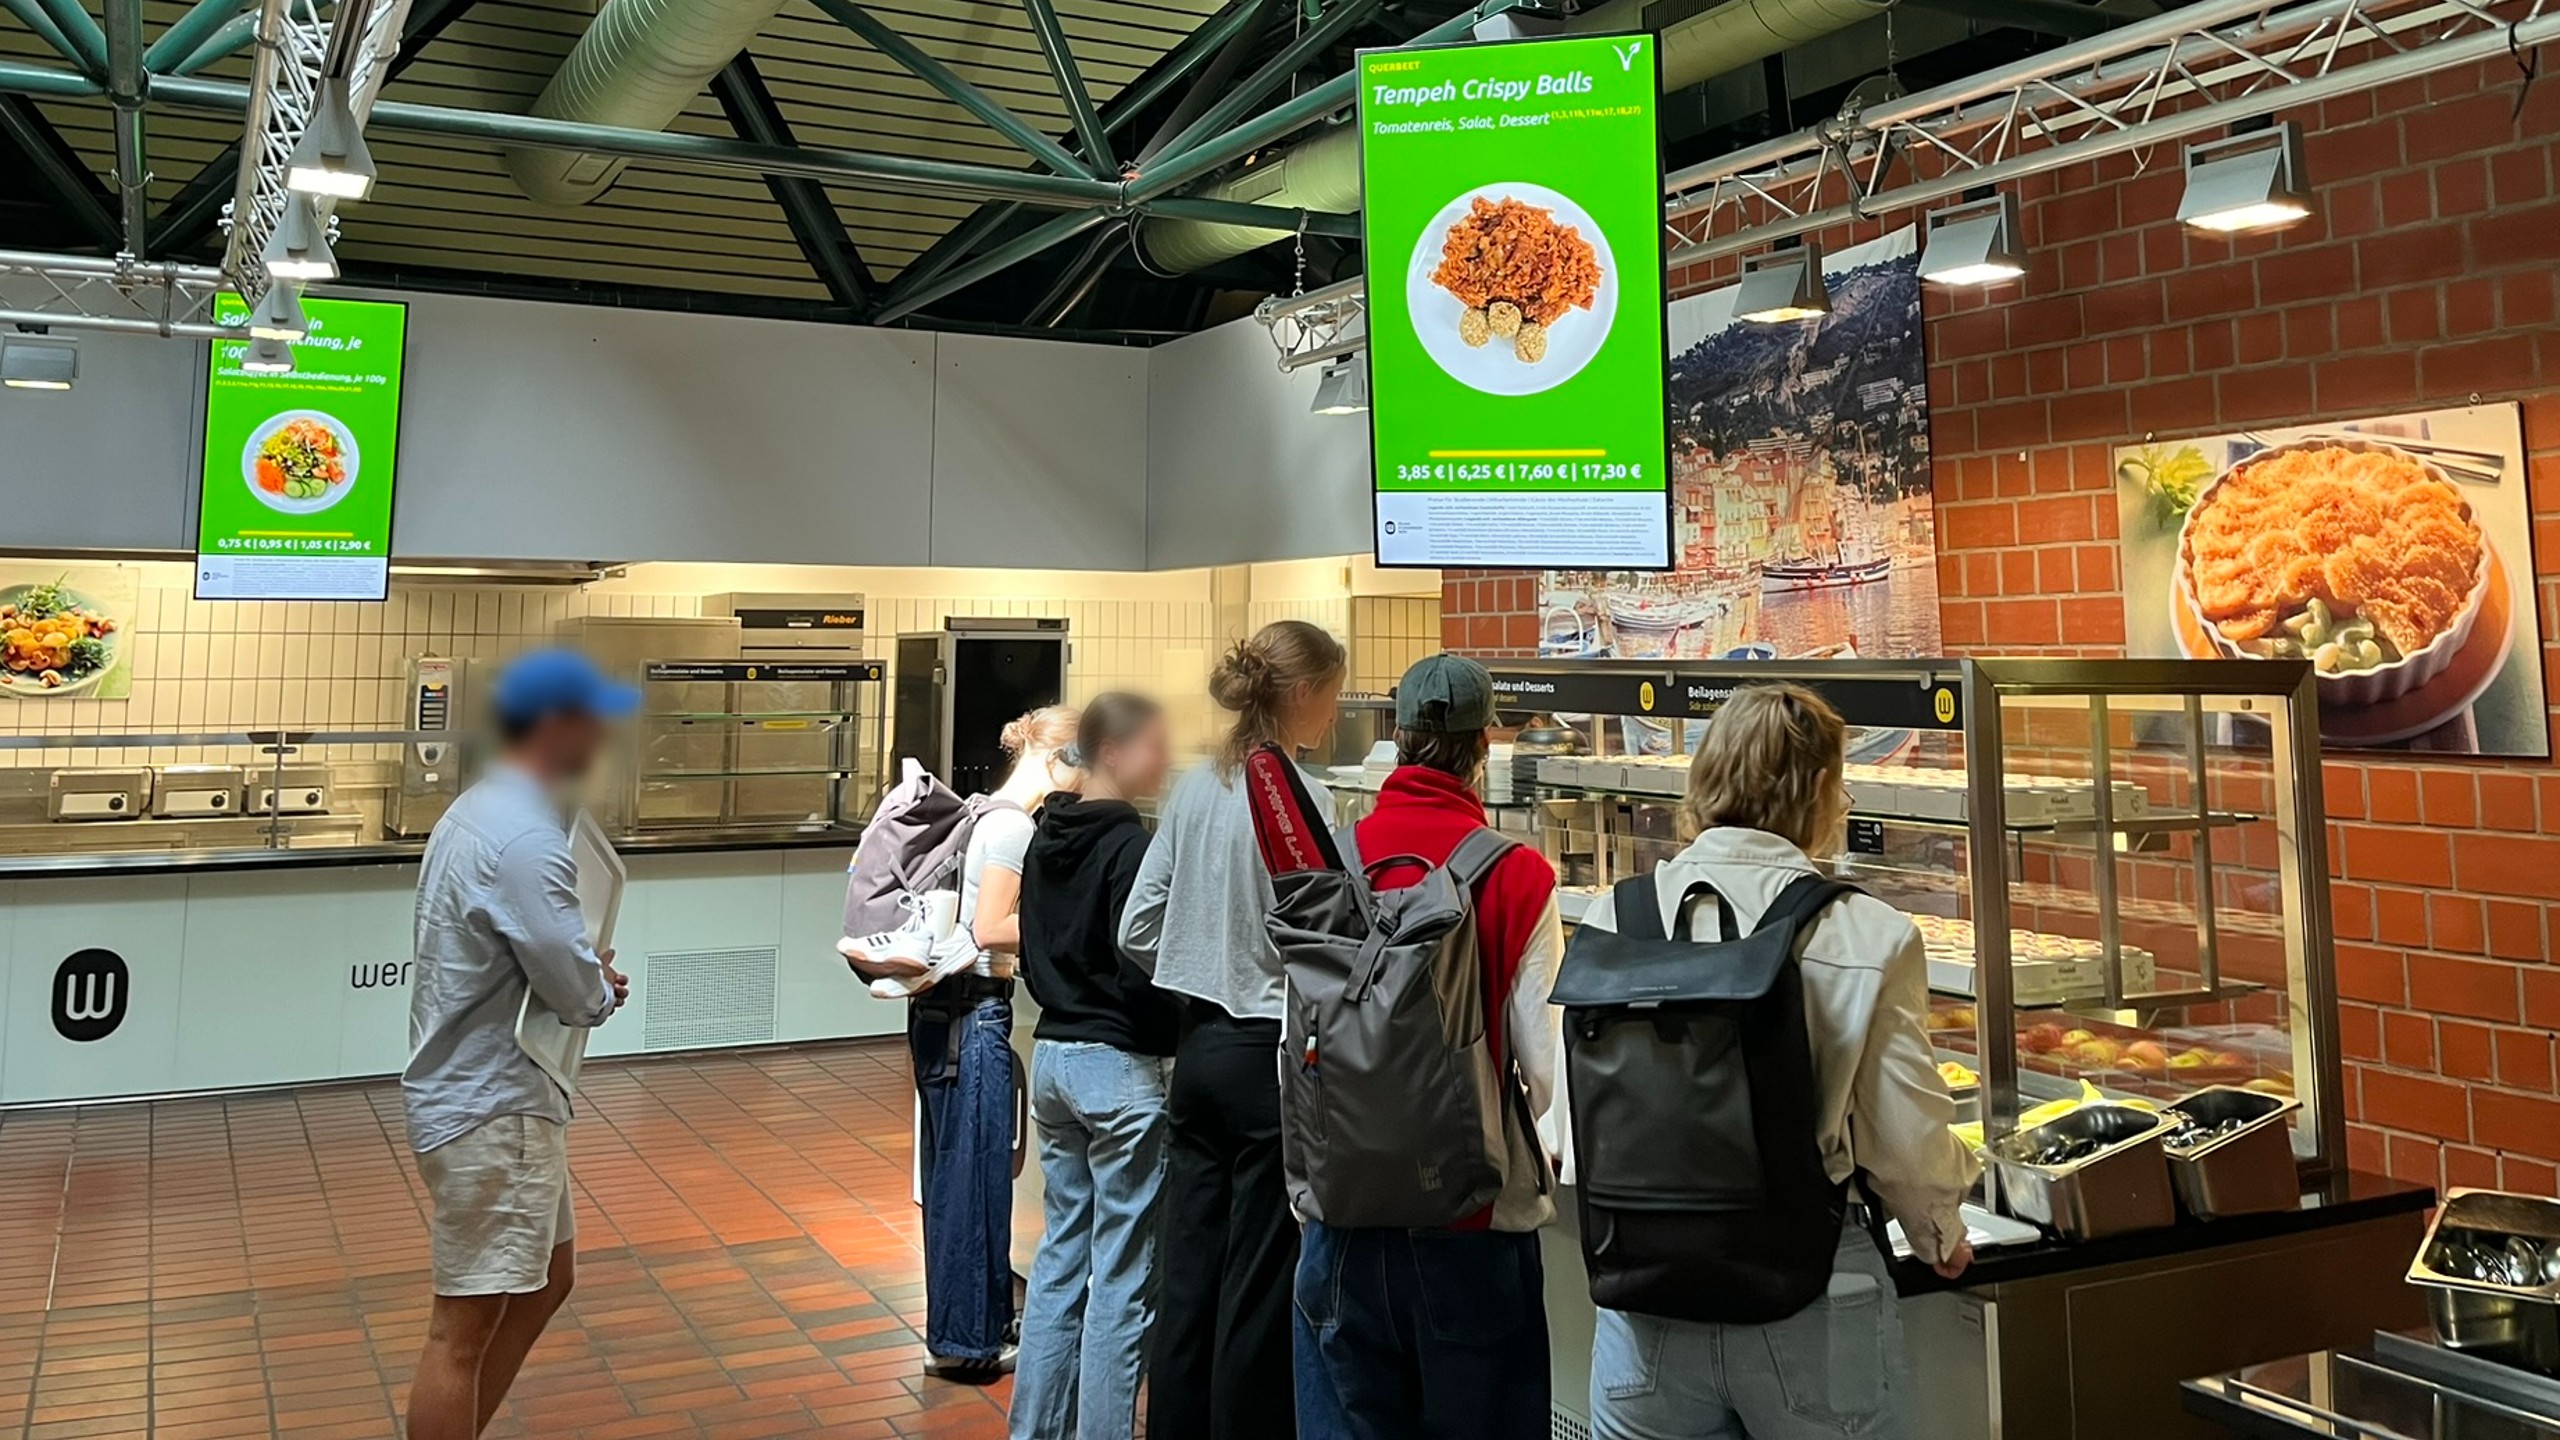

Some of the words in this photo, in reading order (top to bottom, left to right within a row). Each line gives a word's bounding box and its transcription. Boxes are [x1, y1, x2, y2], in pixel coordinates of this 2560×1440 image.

[1369, 60, 1421, 74] QUERBEET
[1373, 79, 1456, 107] Tempeh
[1462, 77, 1531, 102] Crispy
[1536, 71, 1593, 95] Balls
[1373, 115, 1454, 135] Tomatenreis,
[1458, 114, 1496, 131] Salat,
[1499, 112, 1550, 128] Dessert
[345, 337, 362, 351] je
[1397, 464, 1431, 482] 3,85
[1435, 465, 1446, 479] €
[1457, 464, 1492, 482] 6,25
[1496, 465, 1506, 479] €
[1518, 464, 1553, 482] 7,60
[1557, 465, 1568, 479] €
[1582, 464, 1626, 481] 17,30
[1631, 464, 1642, 479] €
[218, 538, 241, 550] 0,75
[243, 539, 251, 548] €
[259, 539, 282, 550] 0,95
[284, 539, 291, 549] €
[301, 540, 322, 551] 1,05
[324, 540, 331, 550] €
[339, 540, 361, 551] 2,90
[363, 541, 371, 550] €
[823, 615, 856, 624] Rieber
[1512, 681, 1525, 692] und
[1525, 681, 1555, 693] Desserts
[352, 961, 413, 988] wer
